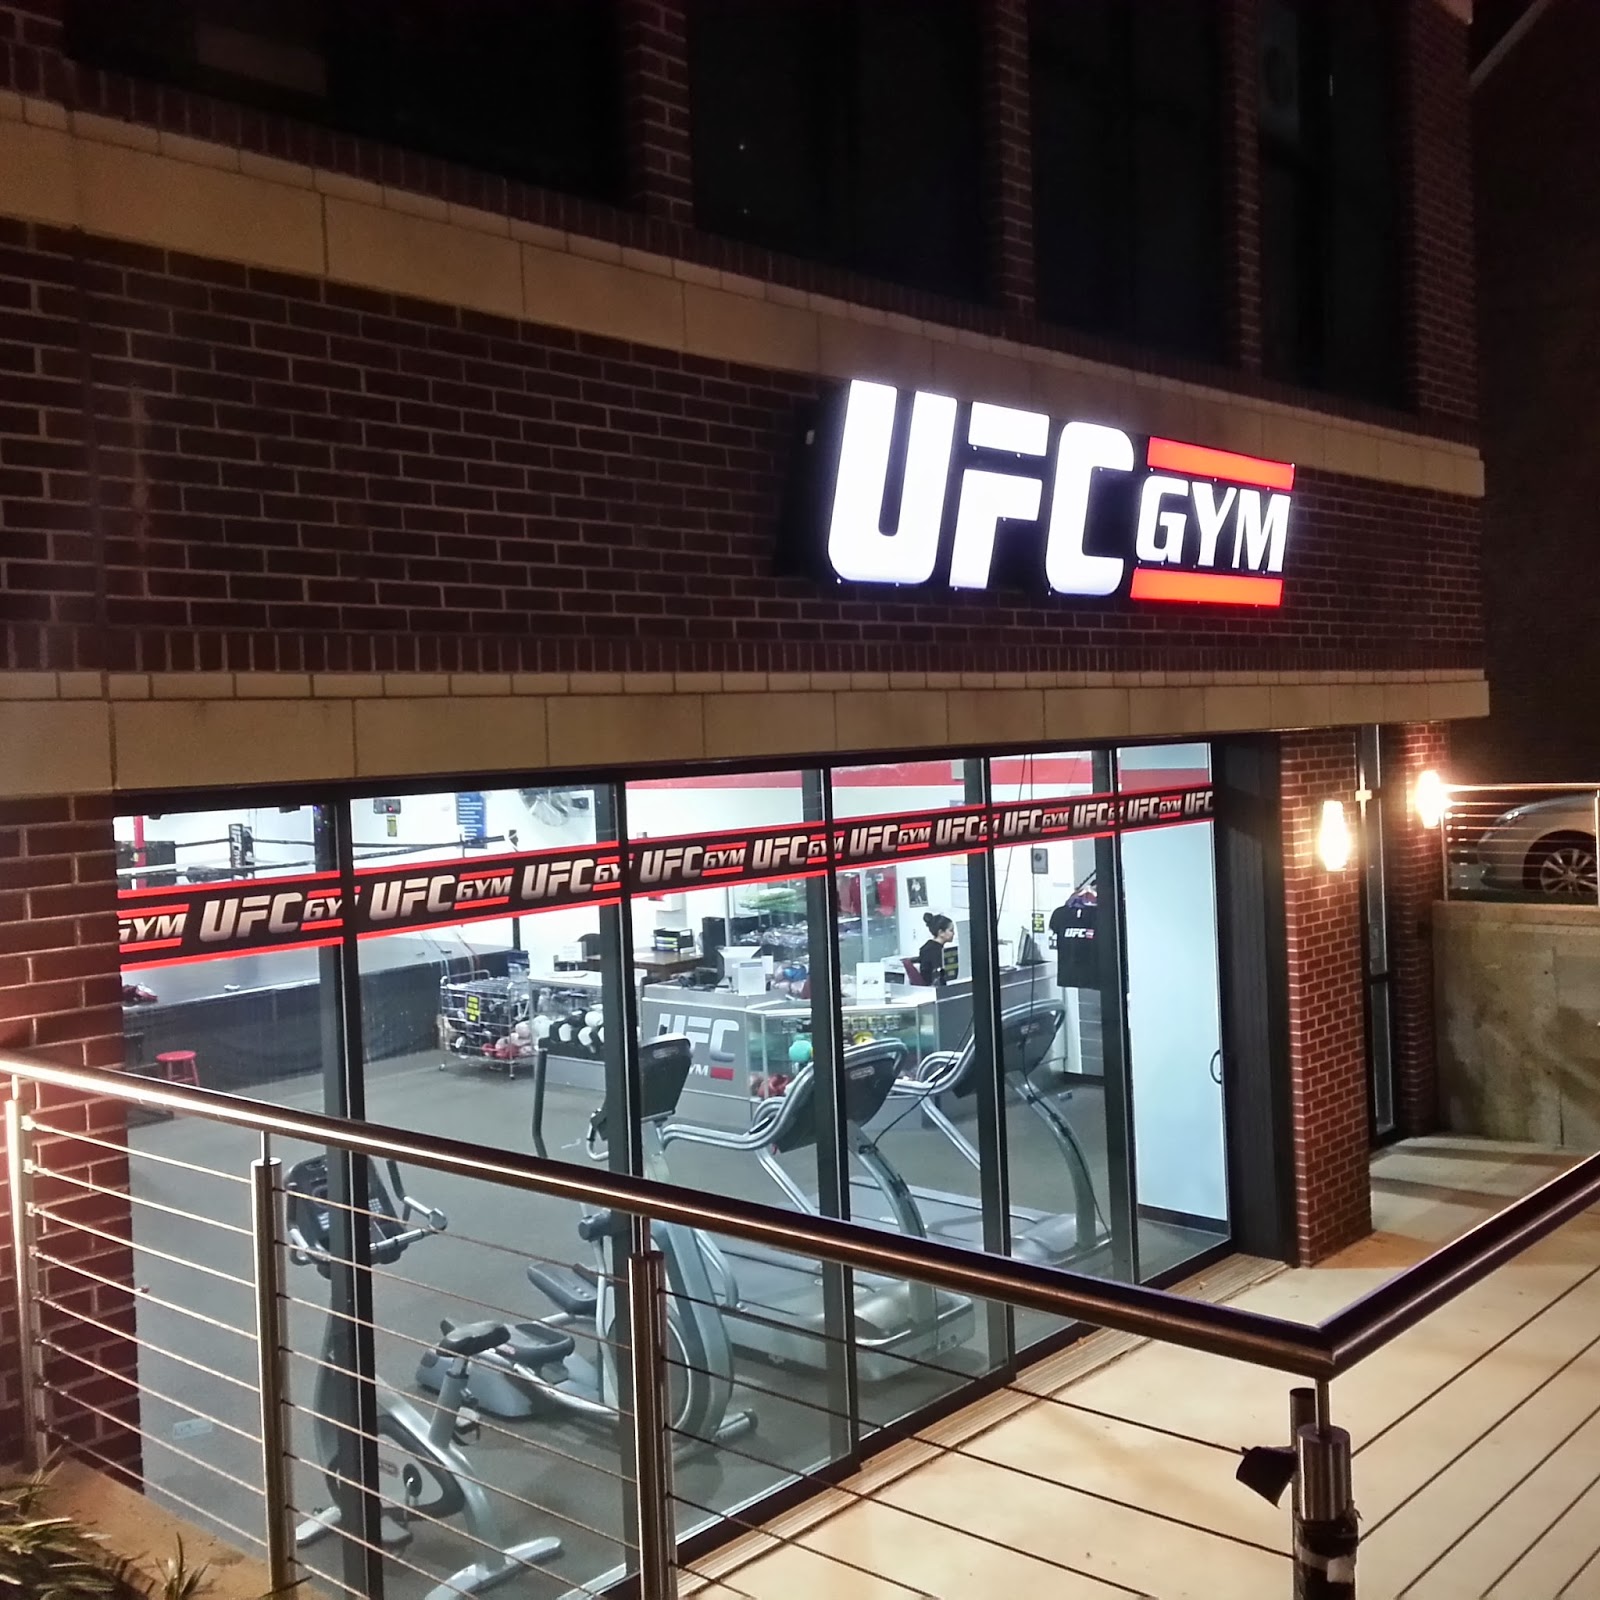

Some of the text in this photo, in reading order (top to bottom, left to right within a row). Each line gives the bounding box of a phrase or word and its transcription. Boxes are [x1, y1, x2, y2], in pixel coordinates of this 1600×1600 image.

[828, 379, 1292, 596] UFC GYM
[1003, 808, 1043, 837] UFC
[1041, 810, 1070, 827] GYM
[1073, 803, 1109, 831] UFC
[1127, 796, 1160, 822] UFC
[1159, 800, 1182, 814] GYM
[1184, 790, 1213, 815] UFC
[850, 824, 898, 857] UFC
[898, 826, 931, 845] GYM
[935, 815, 980, 846] UFC
[639, 845, 704, 884] UFC
[703, 847, 747, 869] GYM
[752, 835, 808, 870] UFC
[369, 858, 620, 921] UFC GYM UFC GY
[200, 892, 303, 943] UFC
[303, 898, 343, 922] GY
[1064, 927, 1087, 938] UFC
[688, 1063, 709, 1076] YM
